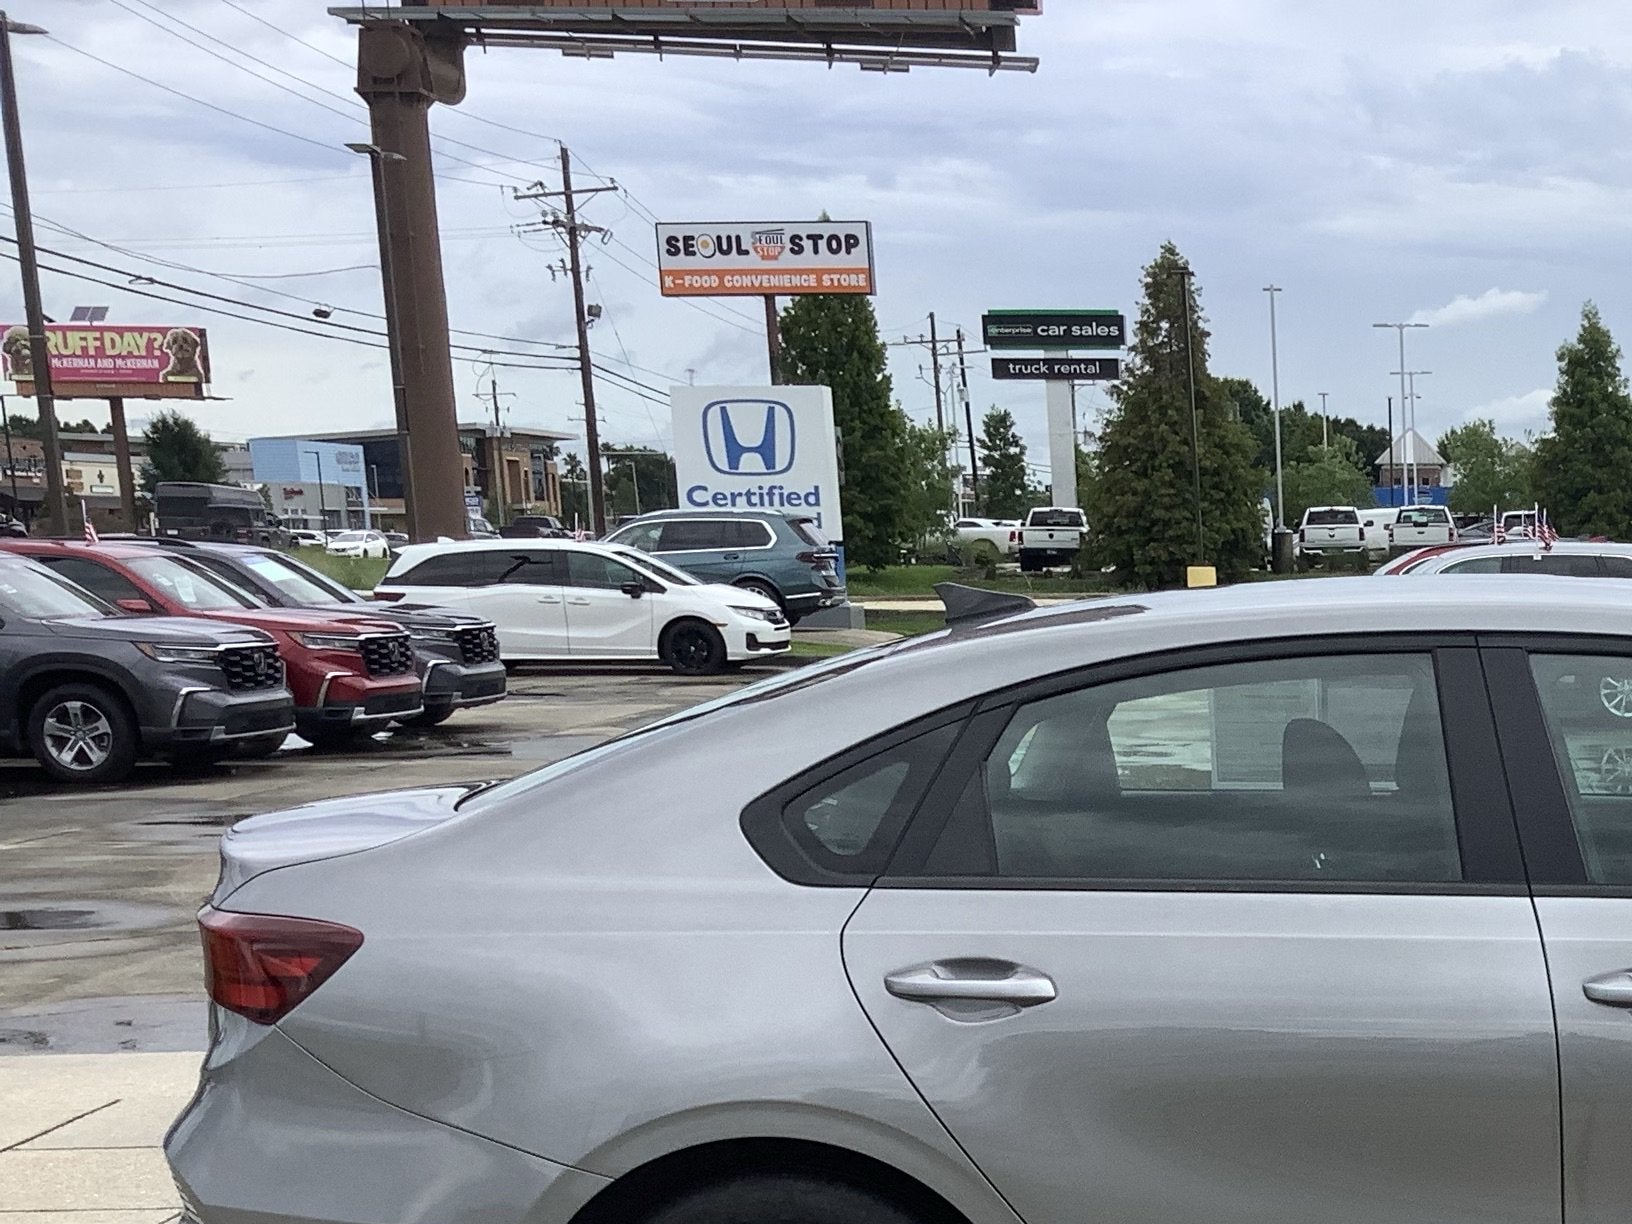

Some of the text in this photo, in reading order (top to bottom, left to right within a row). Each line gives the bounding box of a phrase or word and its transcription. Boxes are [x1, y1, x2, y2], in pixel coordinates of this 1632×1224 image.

[665, 233, 861, 258] SEOUL STOP
[757, 245, 782, 256] STOP
[664, 273, 867, 288] K-FOOD CONVENIENCE STORE
[1037, 325, 1067, 336] car
[1071, 321, 1120, 336] sales
[45, 330, 163, 356] RUFF DAY?
[97, 358, 114, 369] AND
[1008, 361, 1100, 374] truck rental
[686, 485, 821, 507] Certified
